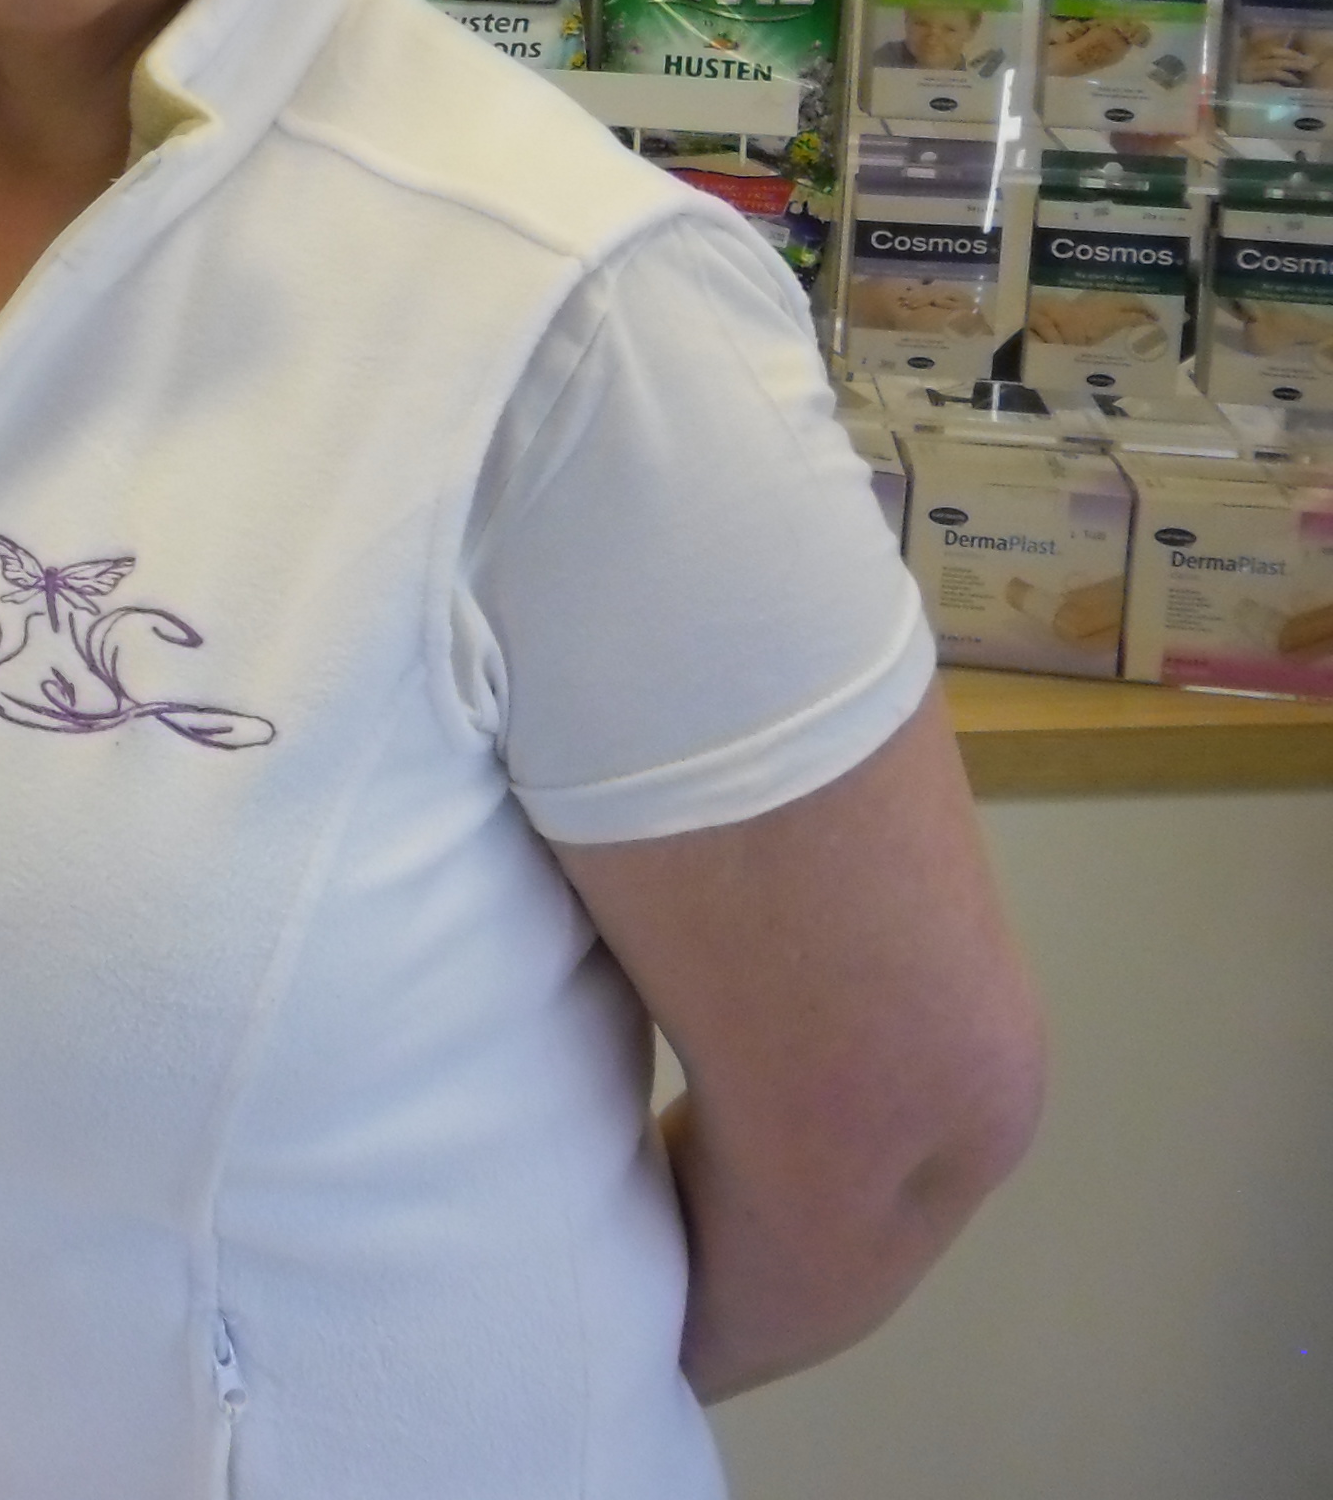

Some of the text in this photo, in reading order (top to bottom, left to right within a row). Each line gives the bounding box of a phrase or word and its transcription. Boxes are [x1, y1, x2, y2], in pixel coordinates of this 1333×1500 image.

[446, 13, 530, 33] usten
[663, 55, 773, 82] HUSTEN
[870, 231, 988, 255] Cosmos
[1050, 238, 1174, 266] Cosmos
[1236, 248, 1333, 275] Cosm
[944, 529, 1057, 556] DermaPlast
[1171, 551, 1288, 577] DermaPlast
